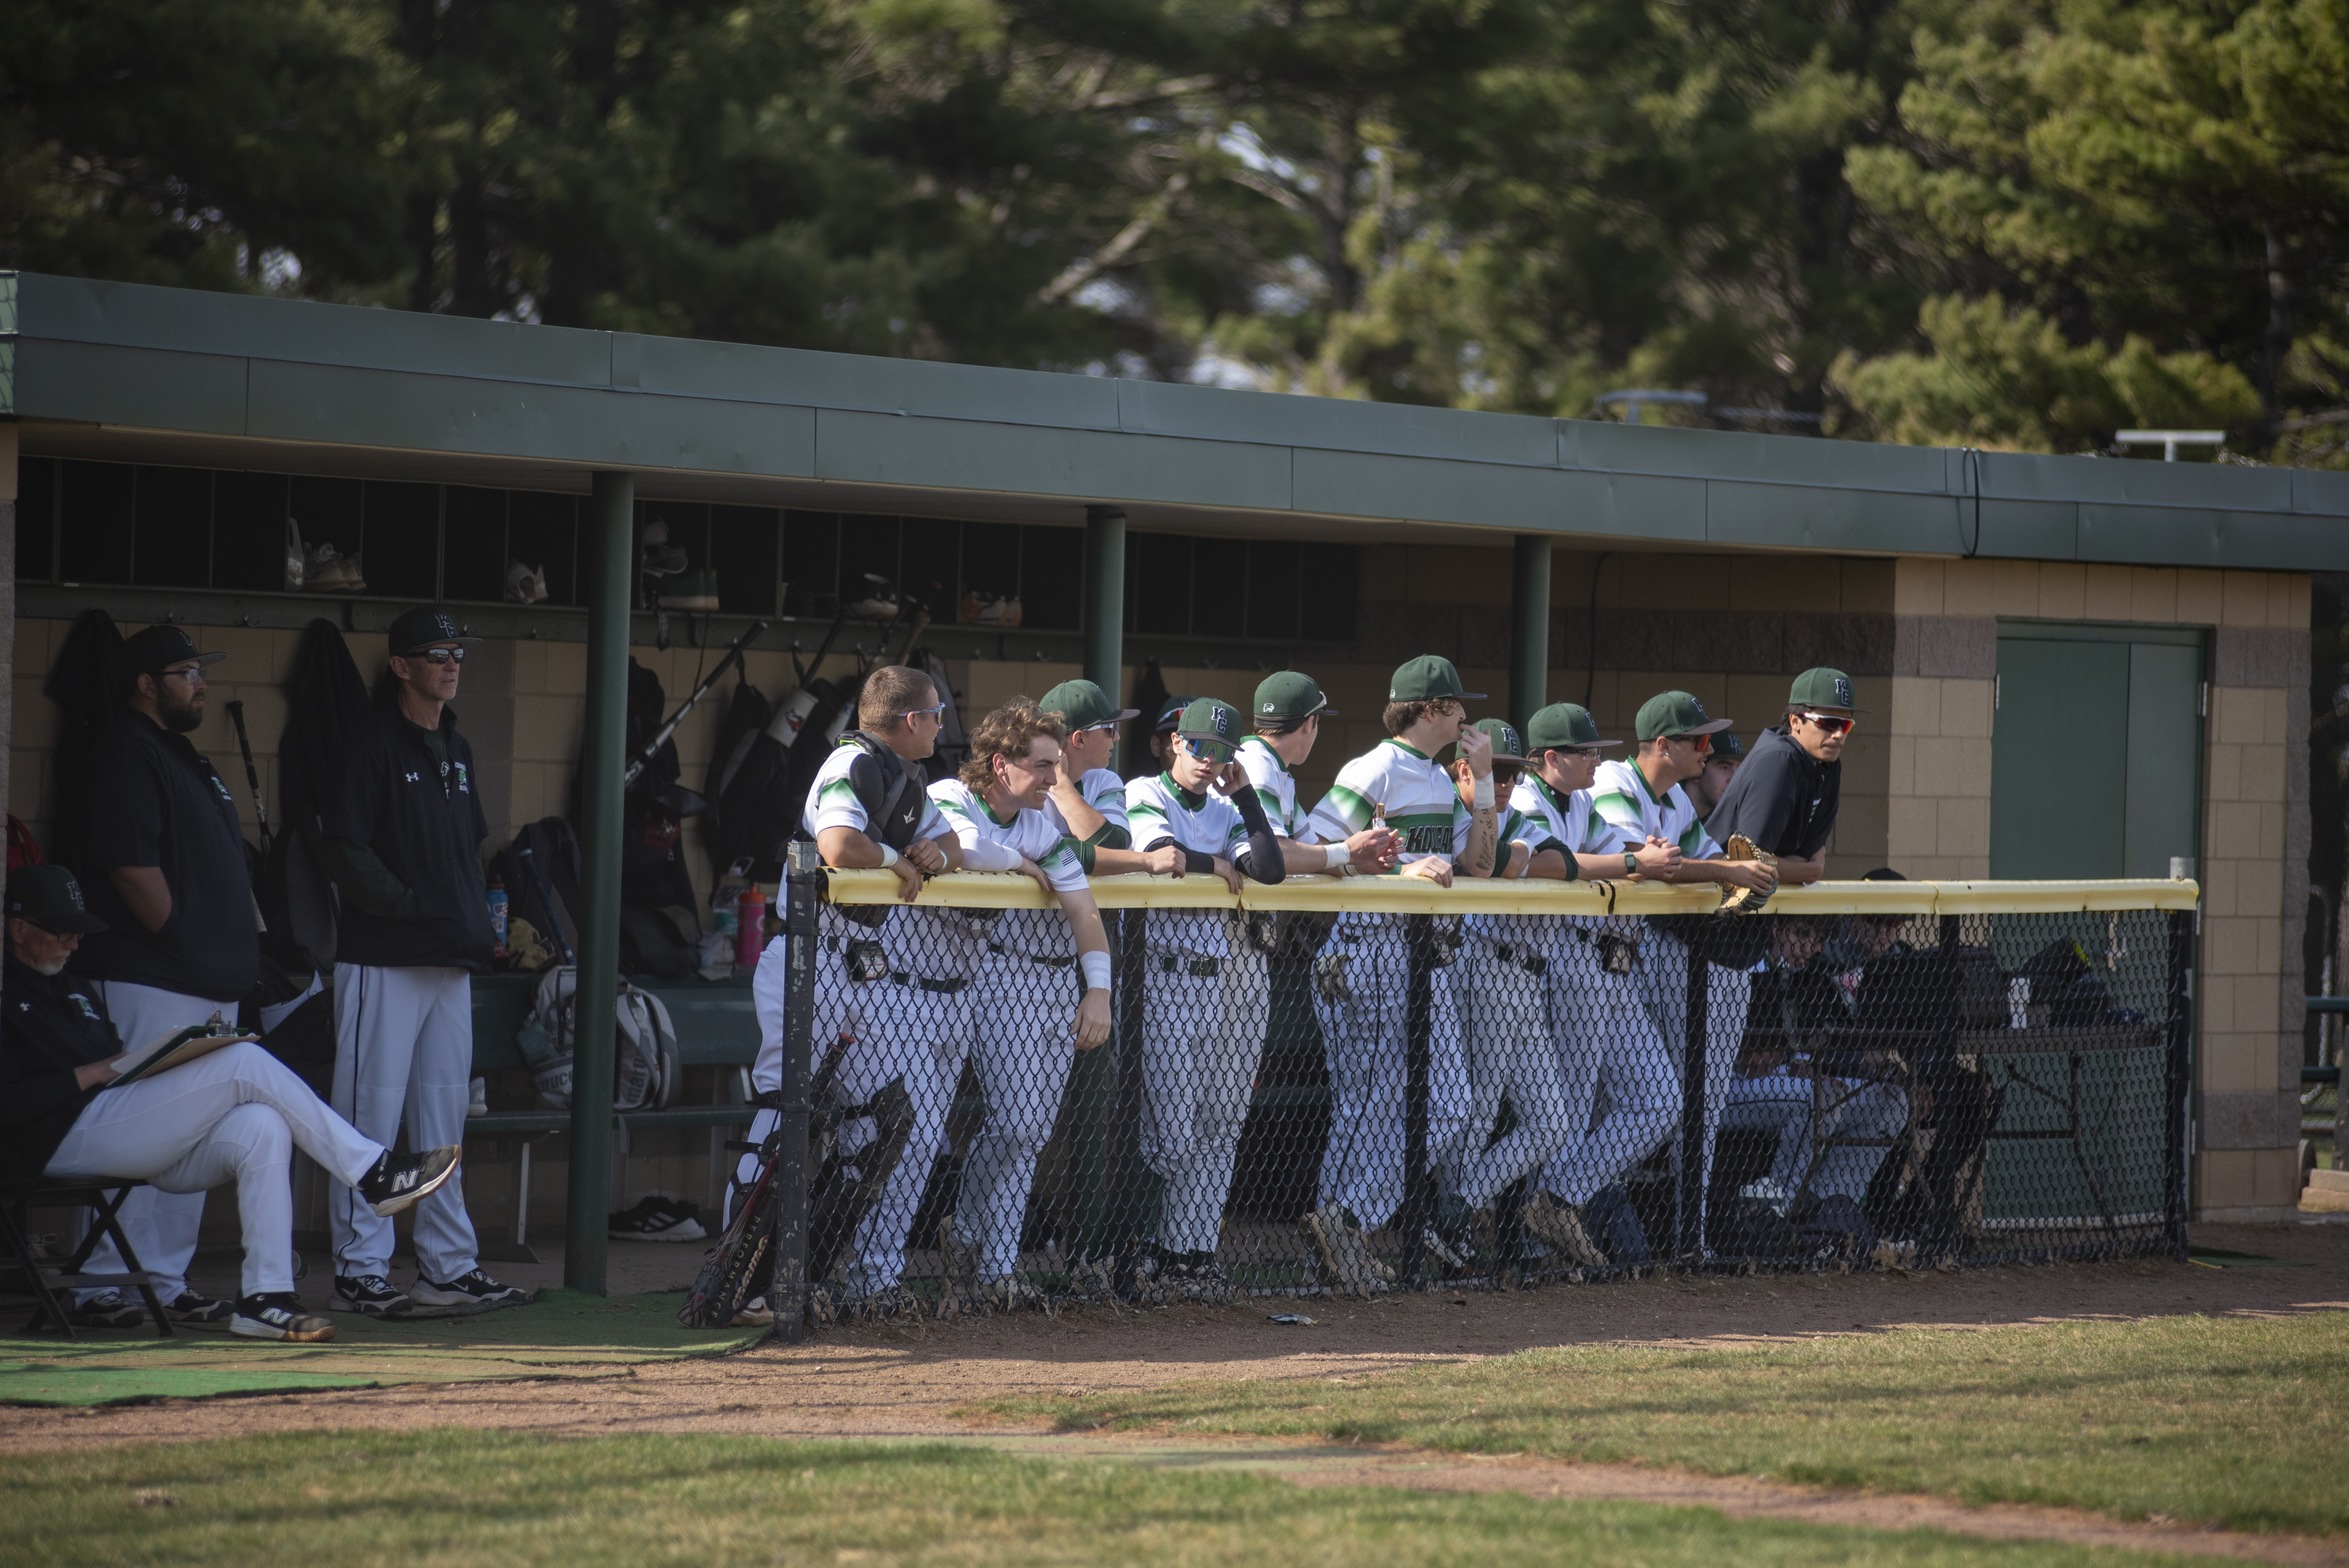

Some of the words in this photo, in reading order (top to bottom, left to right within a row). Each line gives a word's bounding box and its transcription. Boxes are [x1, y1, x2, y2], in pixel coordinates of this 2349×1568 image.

[1834, 678, 1849, 705] KC
[1211, 706, 1227, 734] KC
[1501, 727, 1518, 752] KC
[710, 1215, 761, 1319] PERFORMANCE
